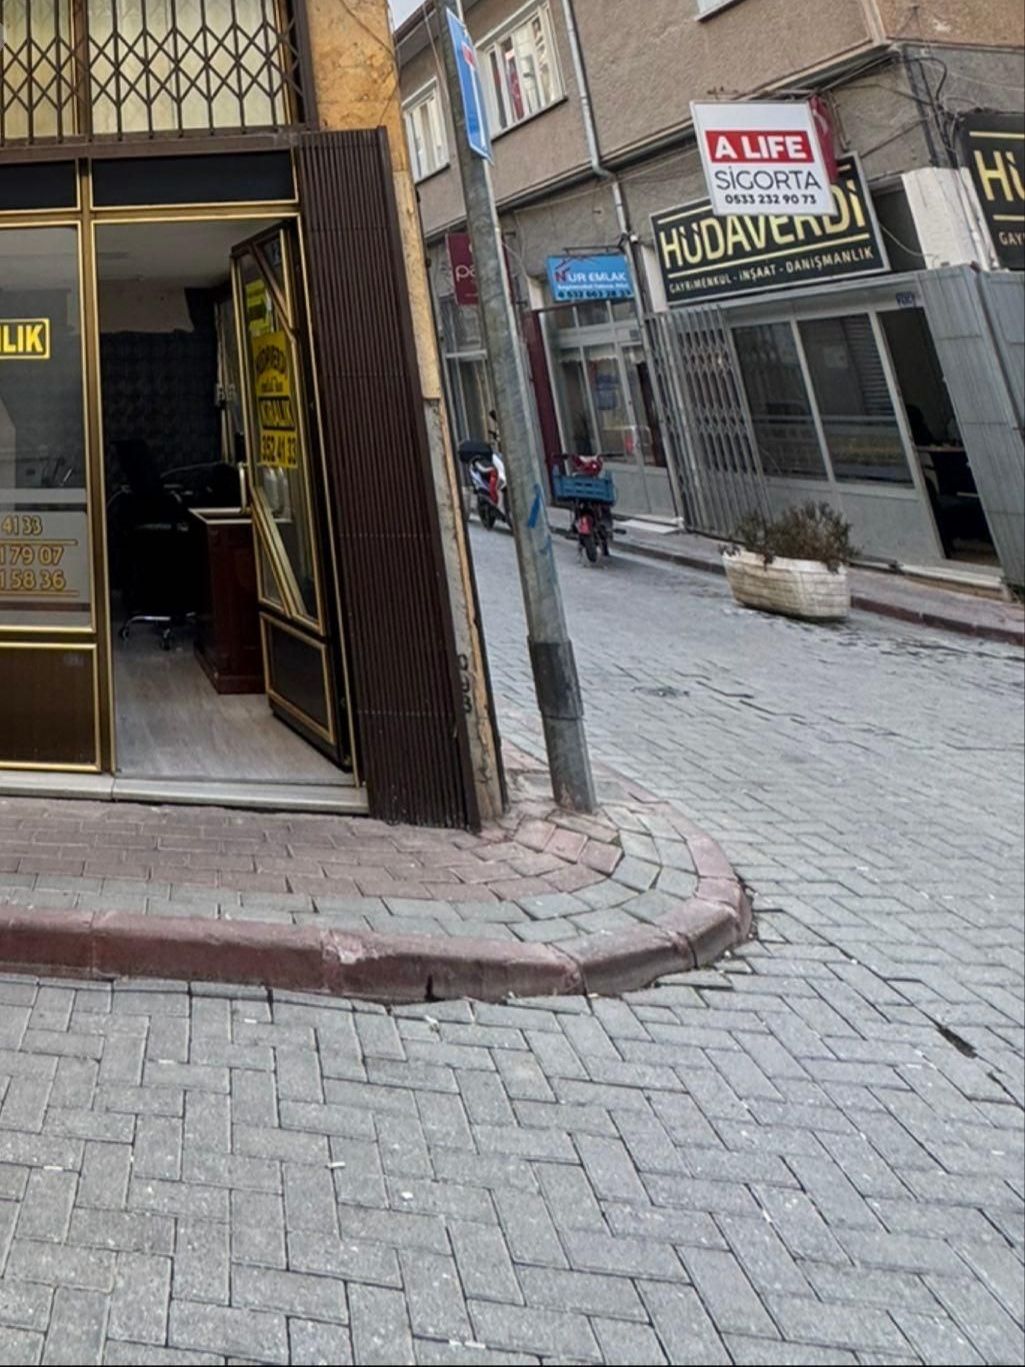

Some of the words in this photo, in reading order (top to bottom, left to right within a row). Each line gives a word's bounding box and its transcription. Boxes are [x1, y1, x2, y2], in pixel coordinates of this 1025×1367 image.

[715, 136, 738, 159] A
[741, 136, 807, 159] LIFE
[714, 165, 821, 190] SİGORTA
[725, 194, 756, 204] 0533
[758, 194, 781, 204] 232
[782, 194, 799, 204] 90
[801, 194, 817, 204] 73
[2, 515, 19, 535] 41
[23, 515, 42, 535] 33
[10, 546, 34, 565] 79
[39, 546, 64, 566] 07
[11, 570, 35, 589] 58
[40, 570, 66, 590] 36
